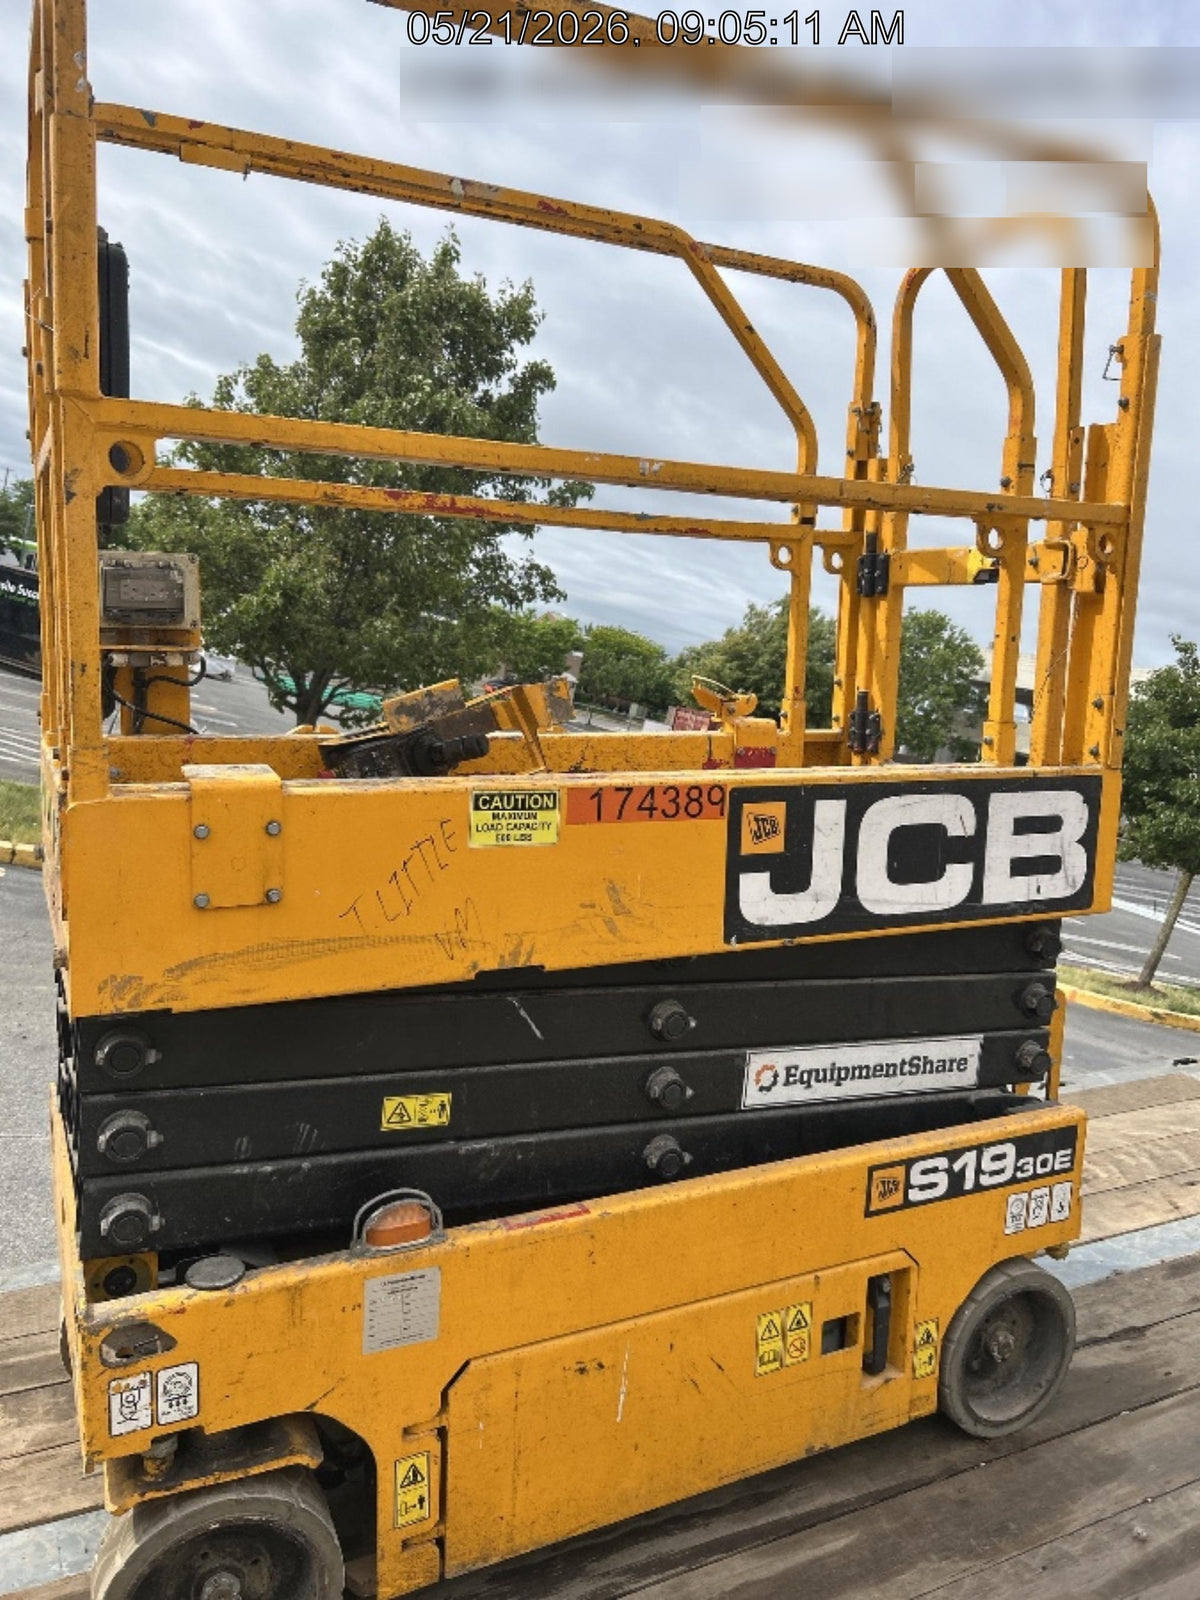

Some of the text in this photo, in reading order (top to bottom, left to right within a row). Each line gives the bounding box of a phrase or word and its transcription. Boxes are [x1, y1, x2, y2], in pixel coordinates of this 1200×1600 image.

[478, 793, 554, 810] CAUTION
[589, 784, 726, 822] 174389
[475, 821, 552, 833] LOAD CAPACITY
[491, 811, 538, 821] MAXIMUM
[752, 815, 779, 841] JCB
[738, 790, 1089, 926] JCB
[782, 1054, 970, 1090] EquipmentShare
